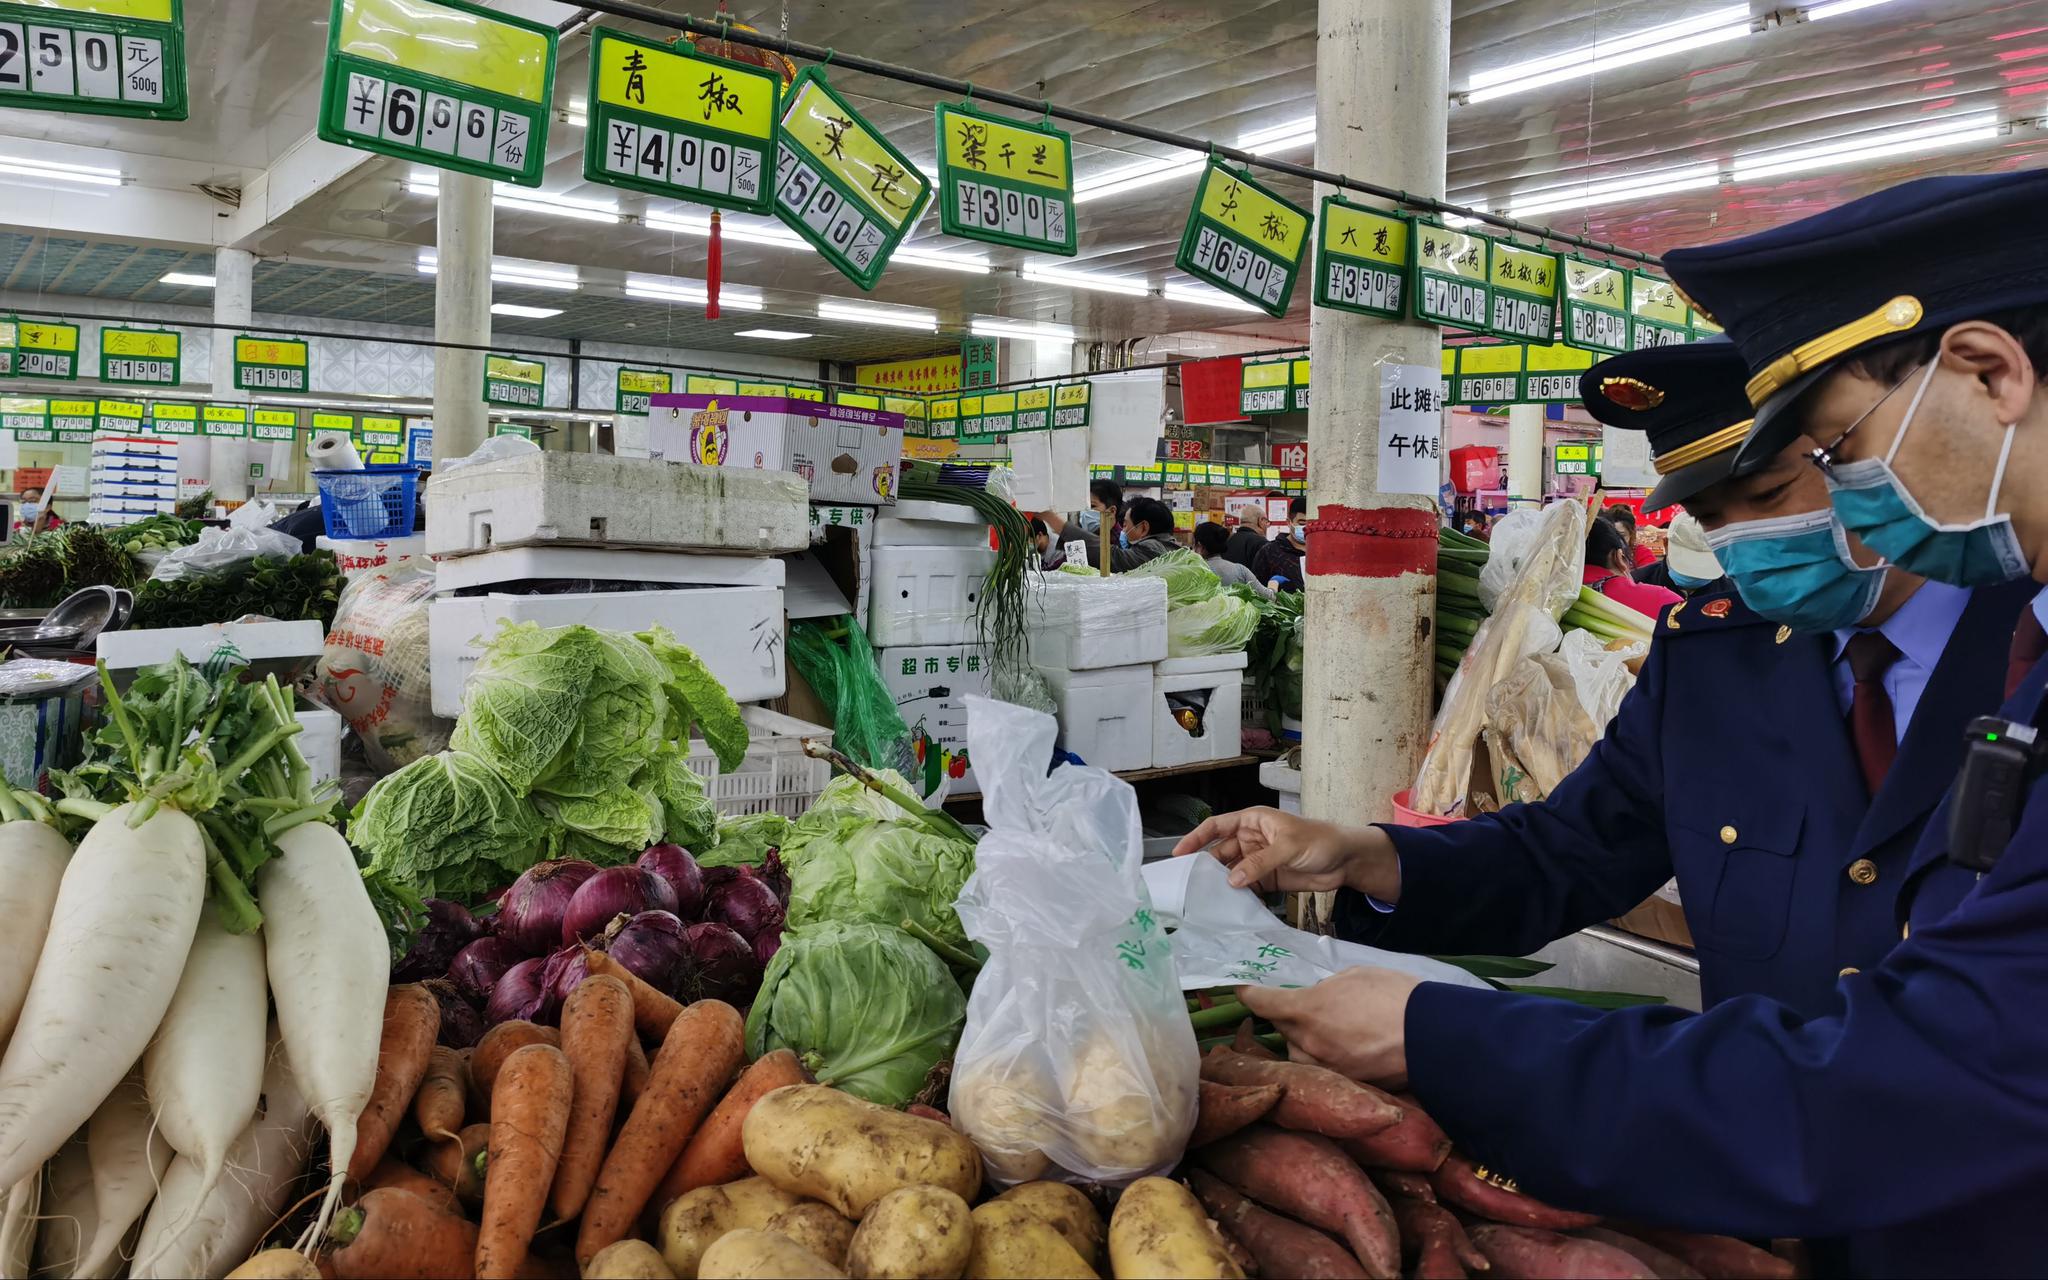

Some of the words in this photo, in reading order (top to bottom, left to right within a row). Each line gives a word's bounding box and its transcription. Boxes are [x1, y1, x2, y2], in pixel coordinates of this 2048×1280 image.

[622, 50, 744, 121] 青椒
[352, 75, 486, 139] ¥6.66
[612, 124, 727, 176] ¥4.00
[959, 184, 1040, 227] ¥3.00
[1199, 230, 1265, 281] ¥6.50
[1341, 226, 1391, 255] 大葱
[1331, 264, 1384, 299] ¥3.50
[1425, 279, 1473, 316] ¥7.00
[110, 333, 163, 355] 冬瓜
[109, 361, 157, 377] ¥1.50
[243, 369, 288, 384] ¥1.50
[1463, 379, 1502, 399] ¥6.66
[1530, 377, 1571, 397] ¥6.66
[902, 655, 980, 675] 超市专供
